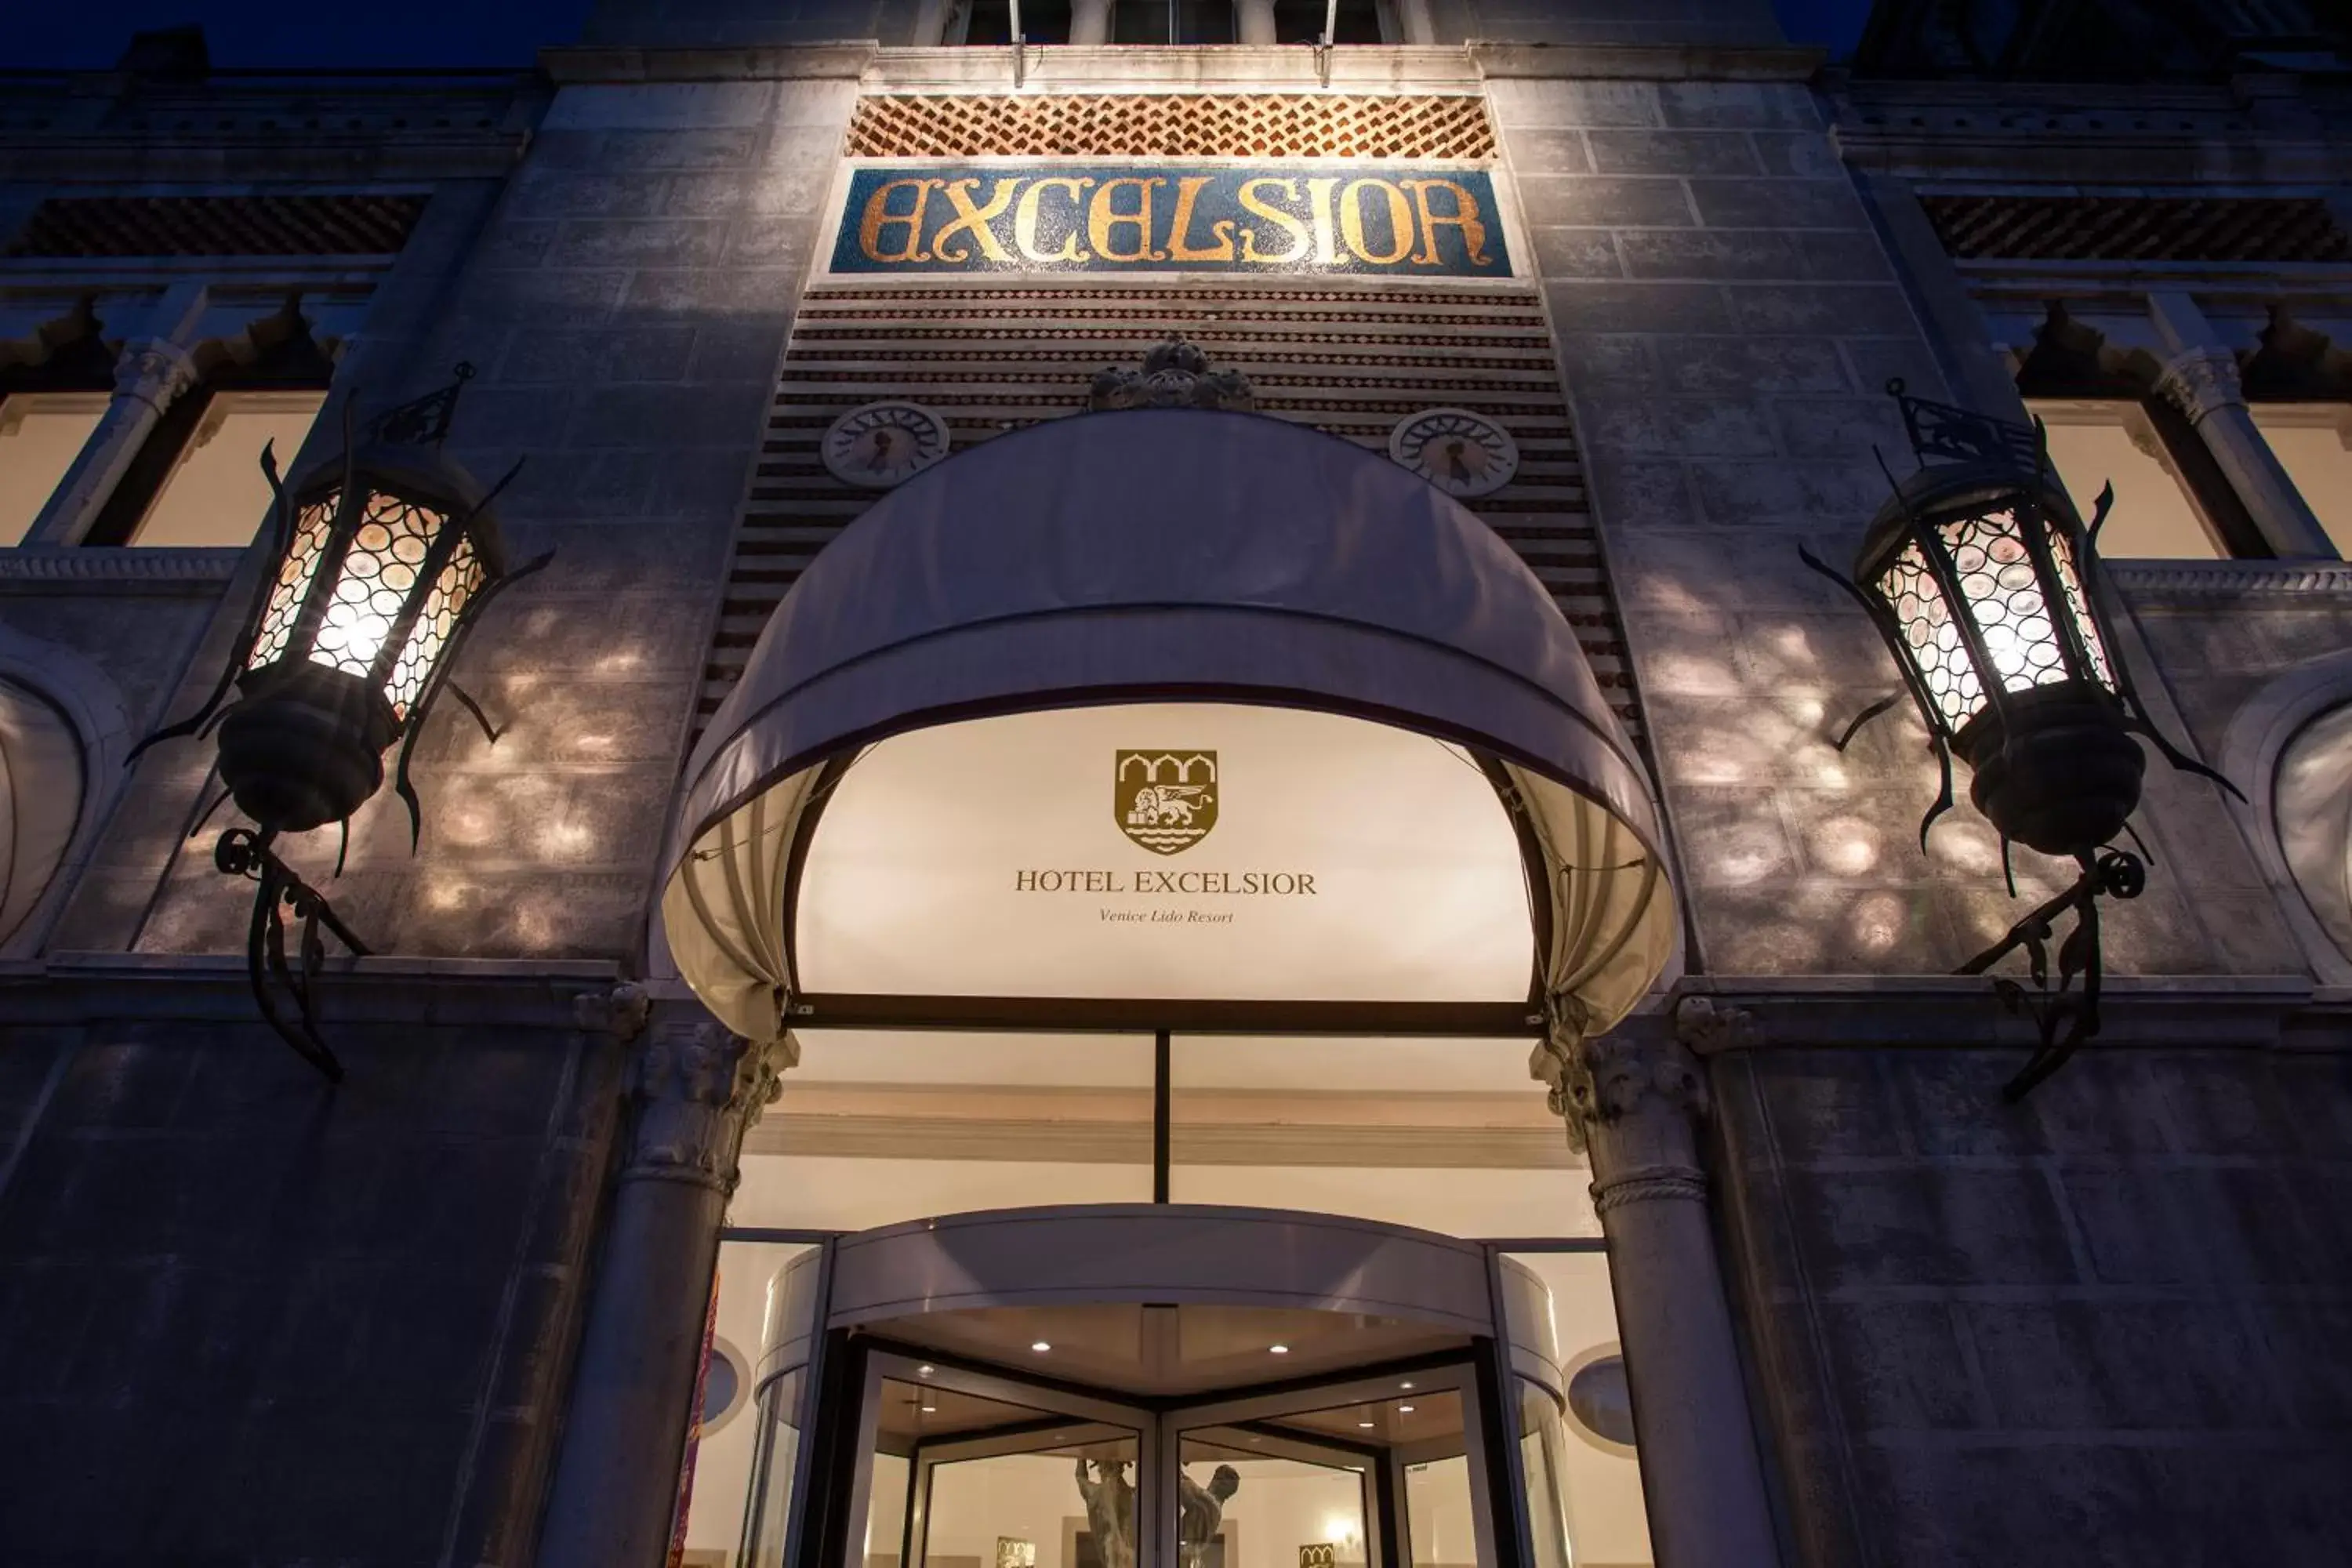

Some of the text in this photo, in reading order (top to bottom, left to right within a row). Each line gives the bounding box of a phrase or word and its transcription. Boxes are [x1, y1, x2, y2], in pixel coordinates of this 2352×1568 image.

[858, 176, 1494, 266] EXCELSIOR
[1015, 869, 1318, 895] HOTEL EXCELSIOR
[1099, 908, 1234, 924] Venice Lido Resort
